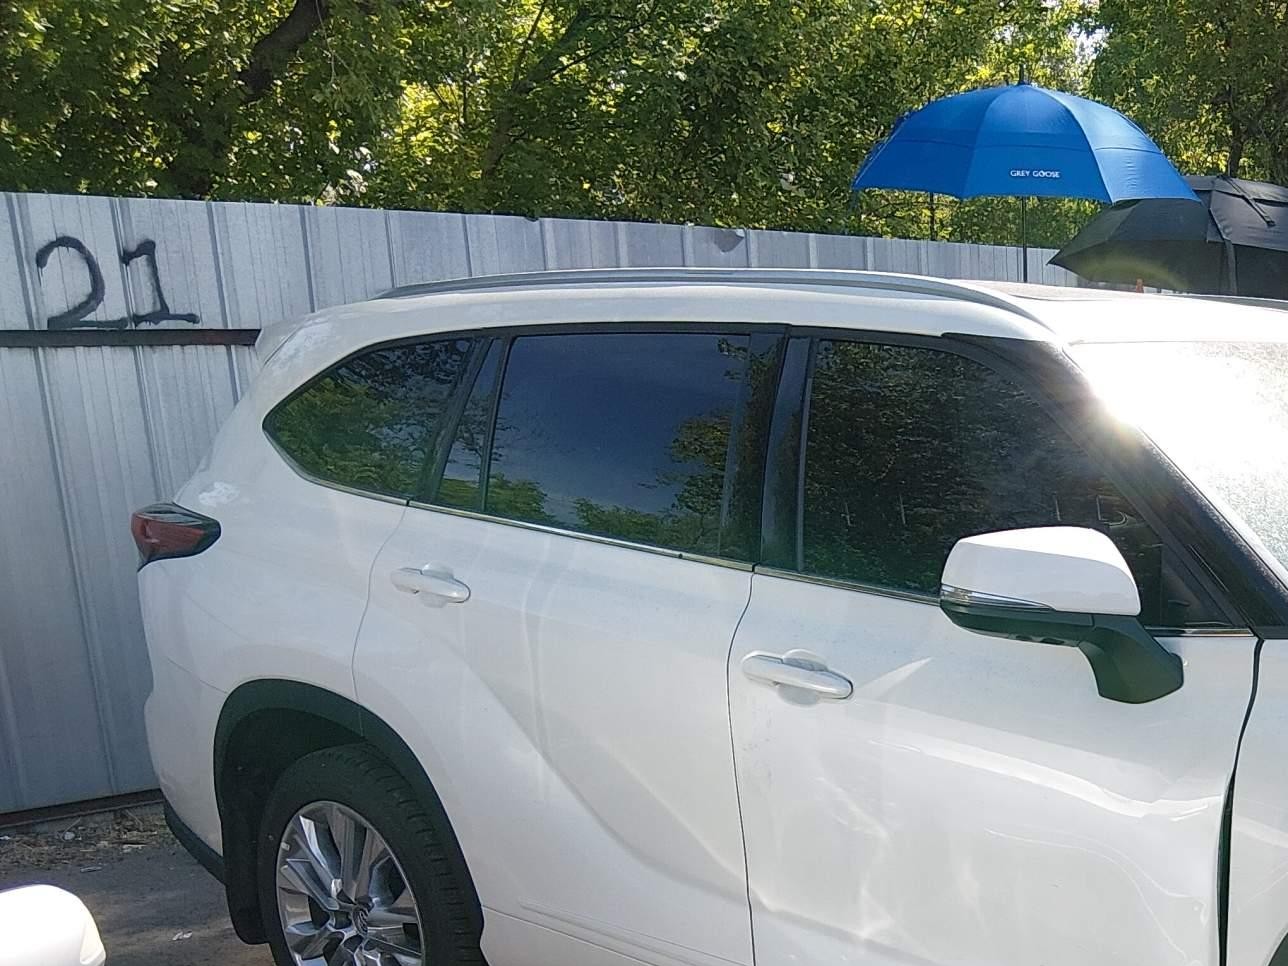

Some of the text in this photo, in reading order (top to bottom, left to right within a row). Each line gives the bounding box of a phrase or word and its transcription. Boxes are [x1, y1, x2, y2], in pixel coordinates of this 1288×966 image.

[1010, 169, 1061, 178] GREY GOOSE
[35, 235, 200, 329] 21
